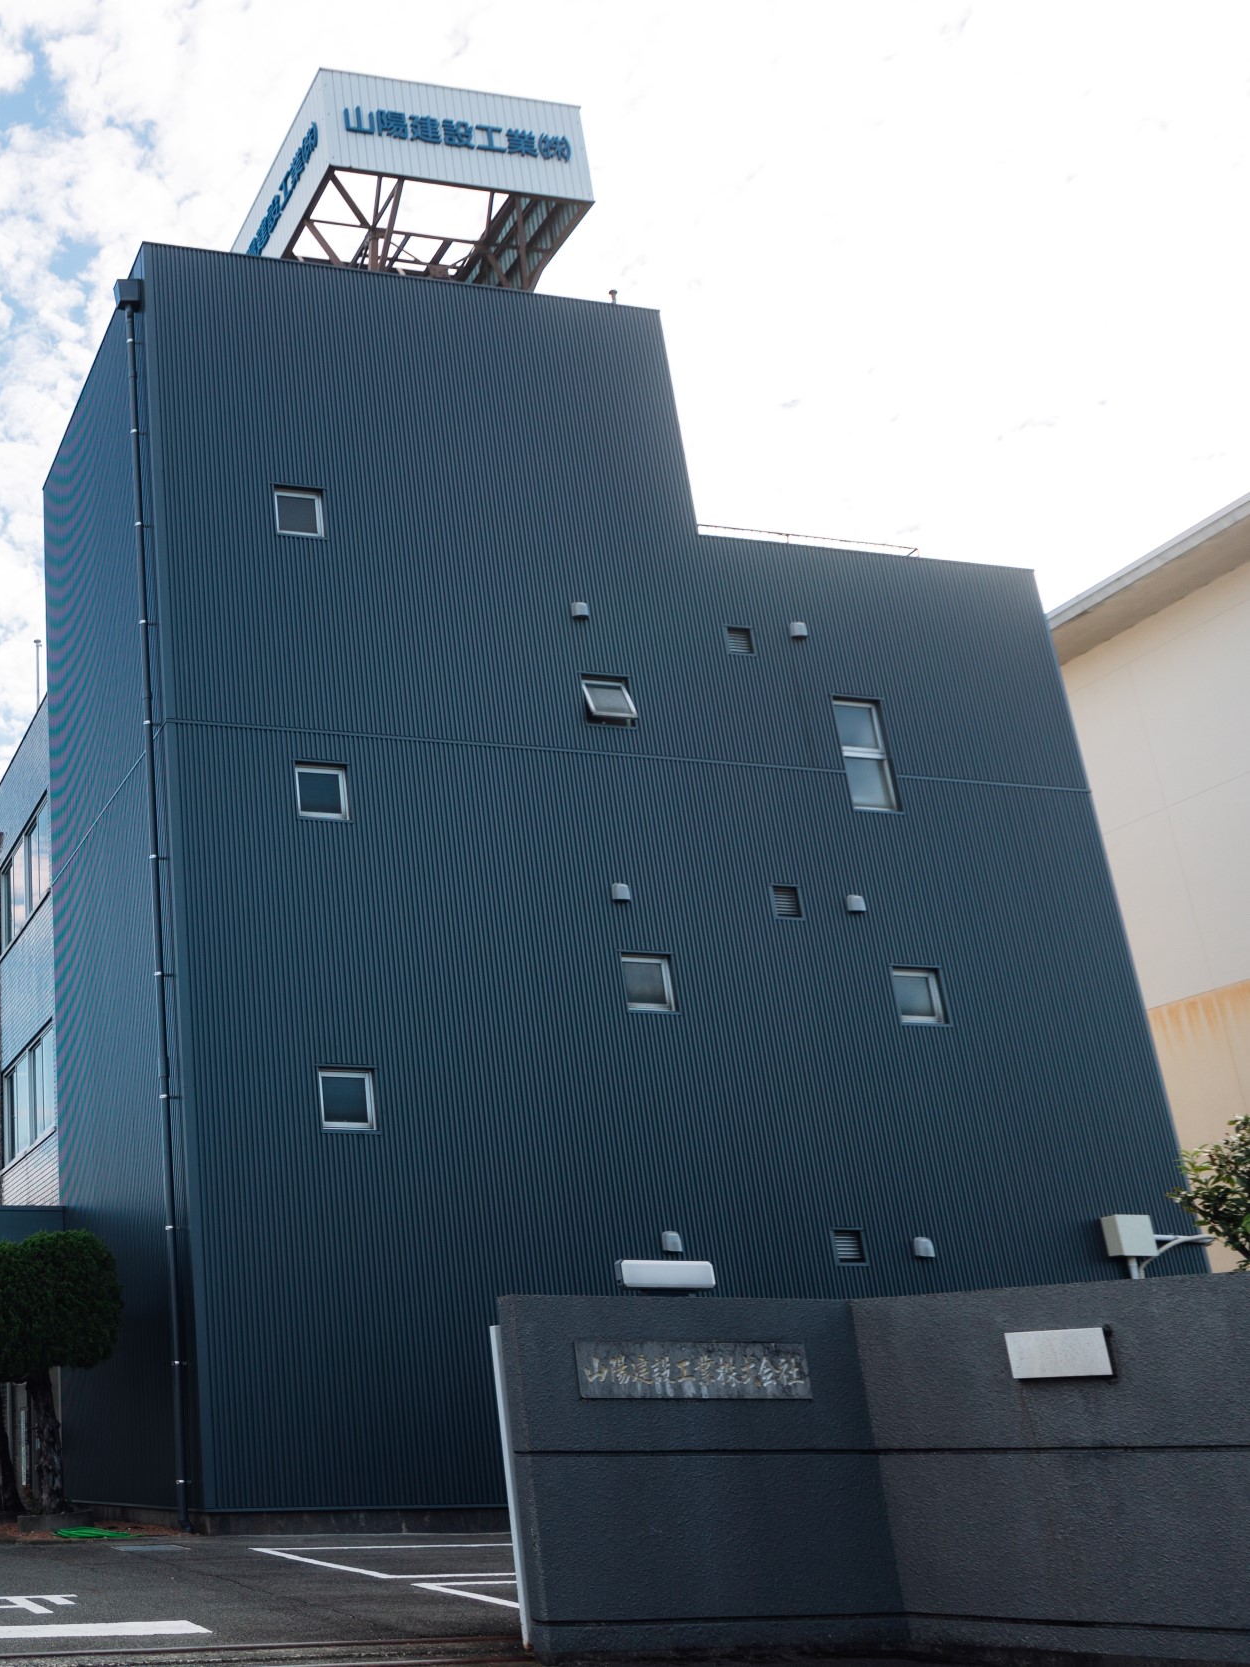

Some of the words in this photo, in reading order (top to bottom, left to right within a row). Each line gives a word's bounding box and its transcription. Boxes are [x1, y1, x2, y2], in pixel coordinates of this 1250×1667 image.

[584, 1354, 804, 1387] 山陽建設工業株式会社
